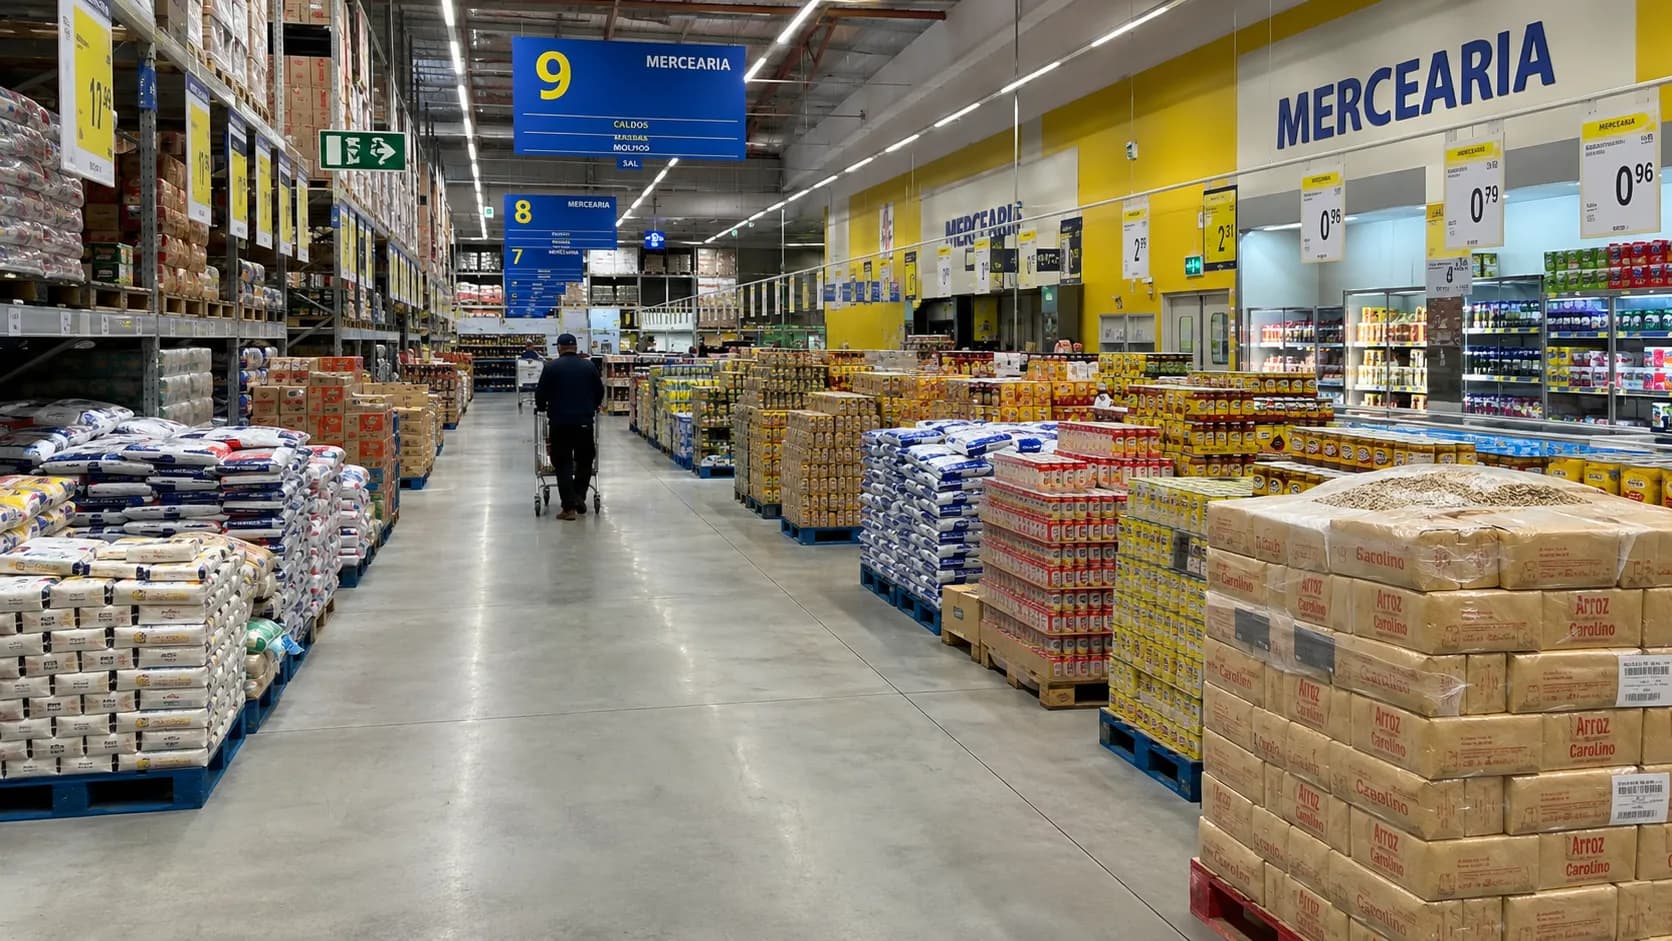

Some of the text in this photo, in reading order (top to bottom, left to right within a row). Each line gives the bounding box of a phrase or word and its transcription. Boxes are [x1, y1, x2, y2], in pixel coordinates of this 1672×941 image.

[646, 55, 731, 70] MERCEARIA
[536, 51, 572, 100] 9
[1277, 21, 1556, 150] MERCEARIA
[613, 120, 649, 129] CALDOS
[622, 160, 639, 168] SAL
[515, 200, 532, 224] 8
[568, 201, 610, 209] MERCEARIA
[512, 249, 523, 265] 7
[1376, 589, 1402, 613] Arroz
[1575, 595, 1609, 615] Arroz
[1373, 615, 1408, 636] Carolino
[1569, 621, 1615, 638] Carolino
[1375, 706, 1400, 733] Arroz
[1576, 717, 1610, 736] Arroz
[1569, 743, 1615, 758] Carolino
[1374, 823, 1399, 852] Arroz
[1572, 836, 1604, 855] Arroz
[1566, 860, 1610, 877] Carolino
